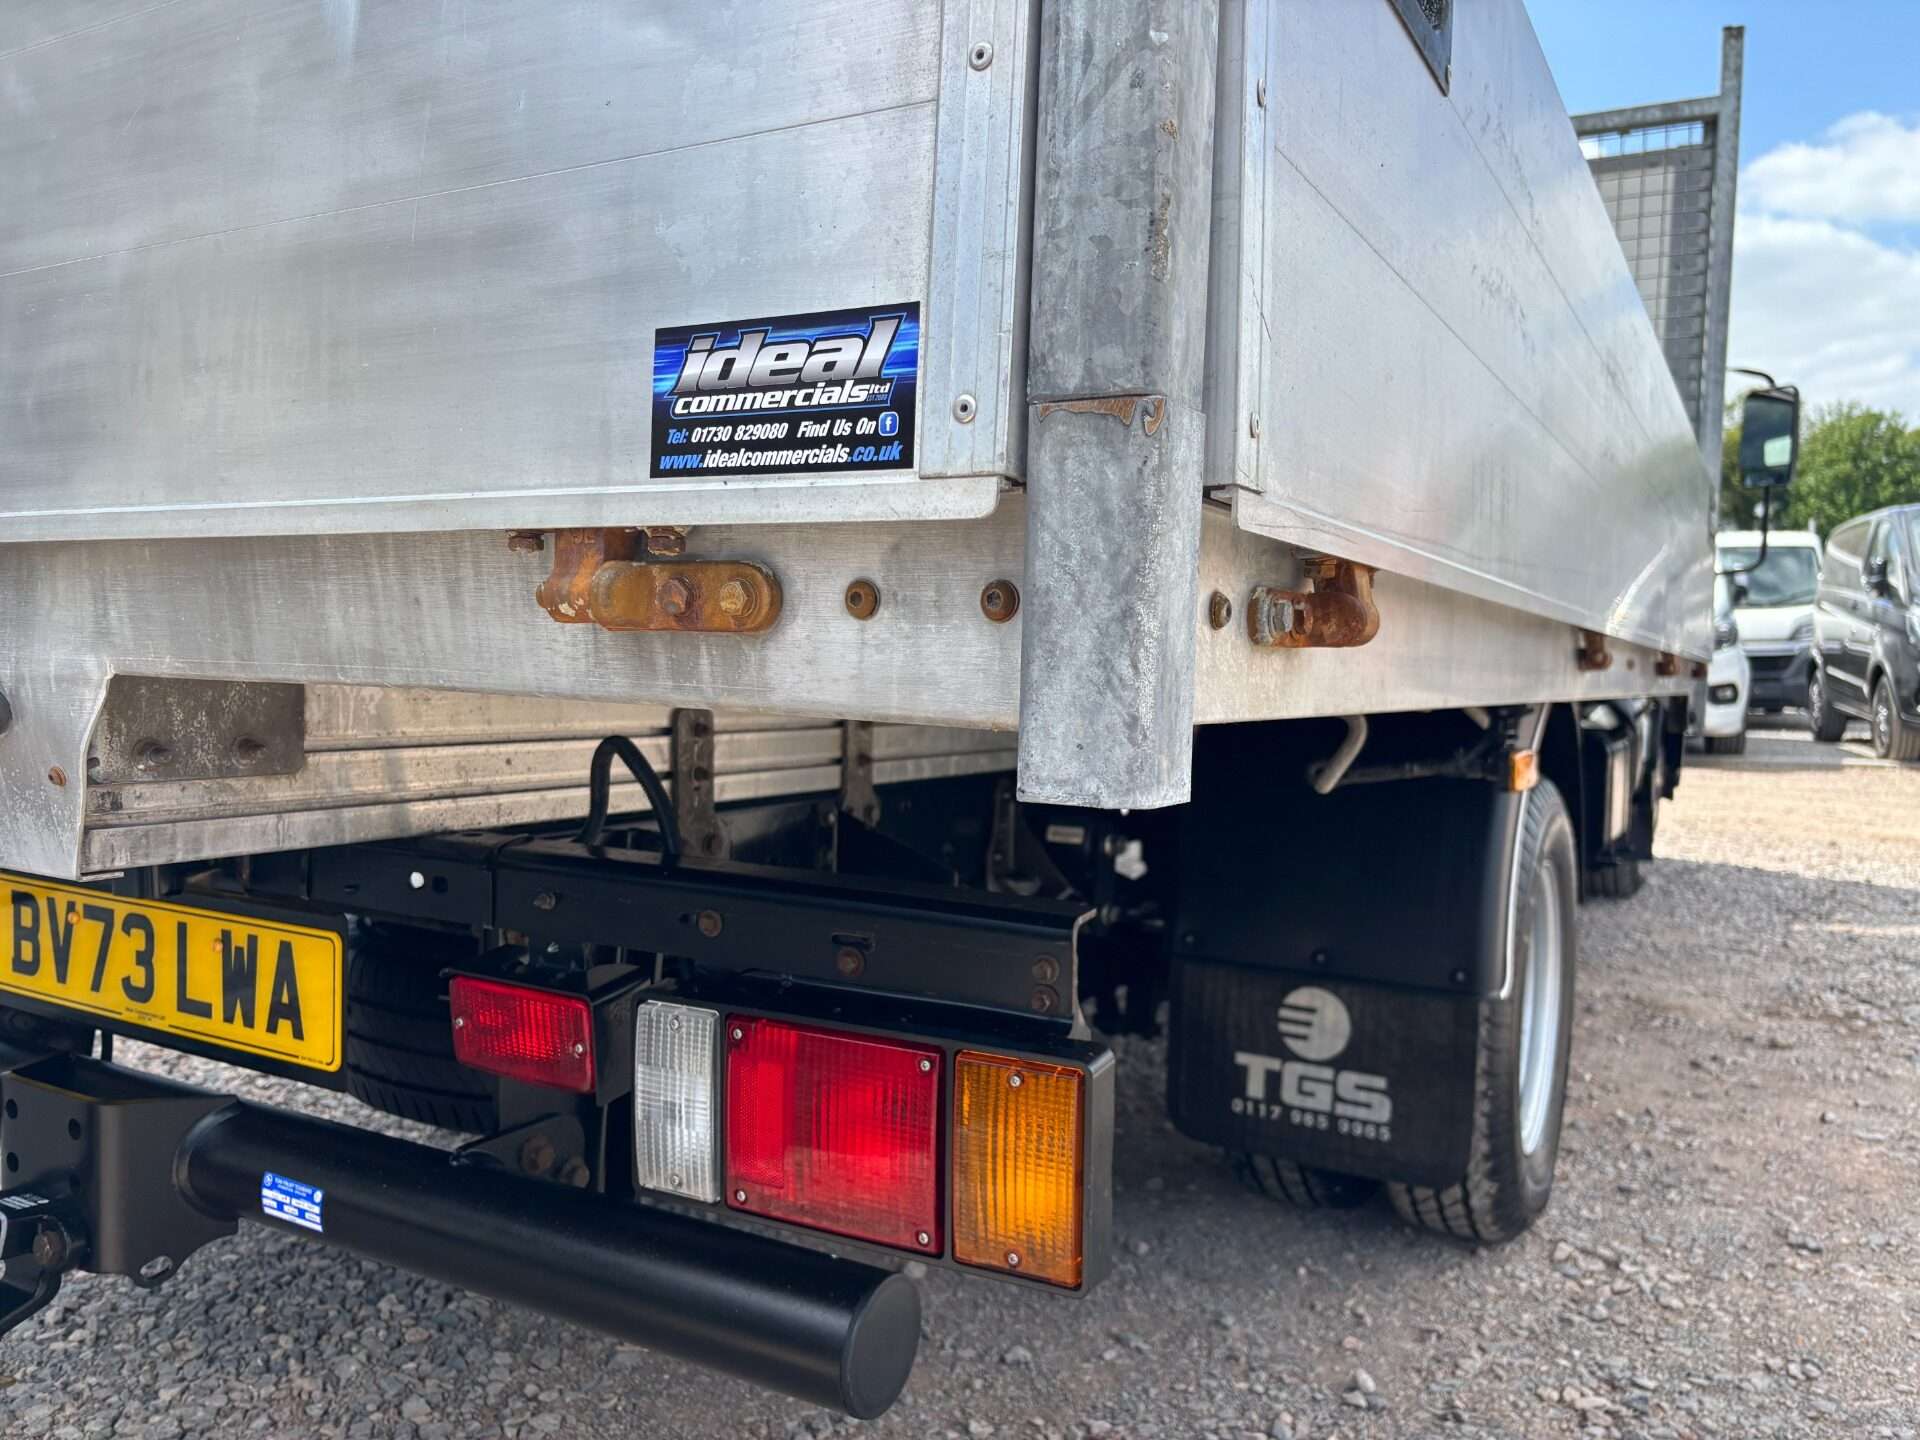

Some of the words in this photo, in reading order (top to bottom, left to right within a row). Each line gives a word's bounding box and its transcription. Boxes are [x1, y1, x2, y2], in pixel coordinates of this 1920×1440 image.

[672, 316, 901, 394] ideal
[673, 380, 869, 415] commercials
[868, 382, 891, 395] ltd
[659, 441, 904, 470] www.idealcommercials.co.uk
[667, 428, 689, 444] Tel:
[691, 426, 731, 443] 01730
[735, 422, 788, 441] 829080
[797, 420, 829, 438] Find
[833, 418, 853, 436] Us
[856, 417, 877, 435] On
[11, 889, 155, 1004] BV73
[177, 920, 305, 1041] LWA
[1233, 1051, 1392, 1123] TGS
